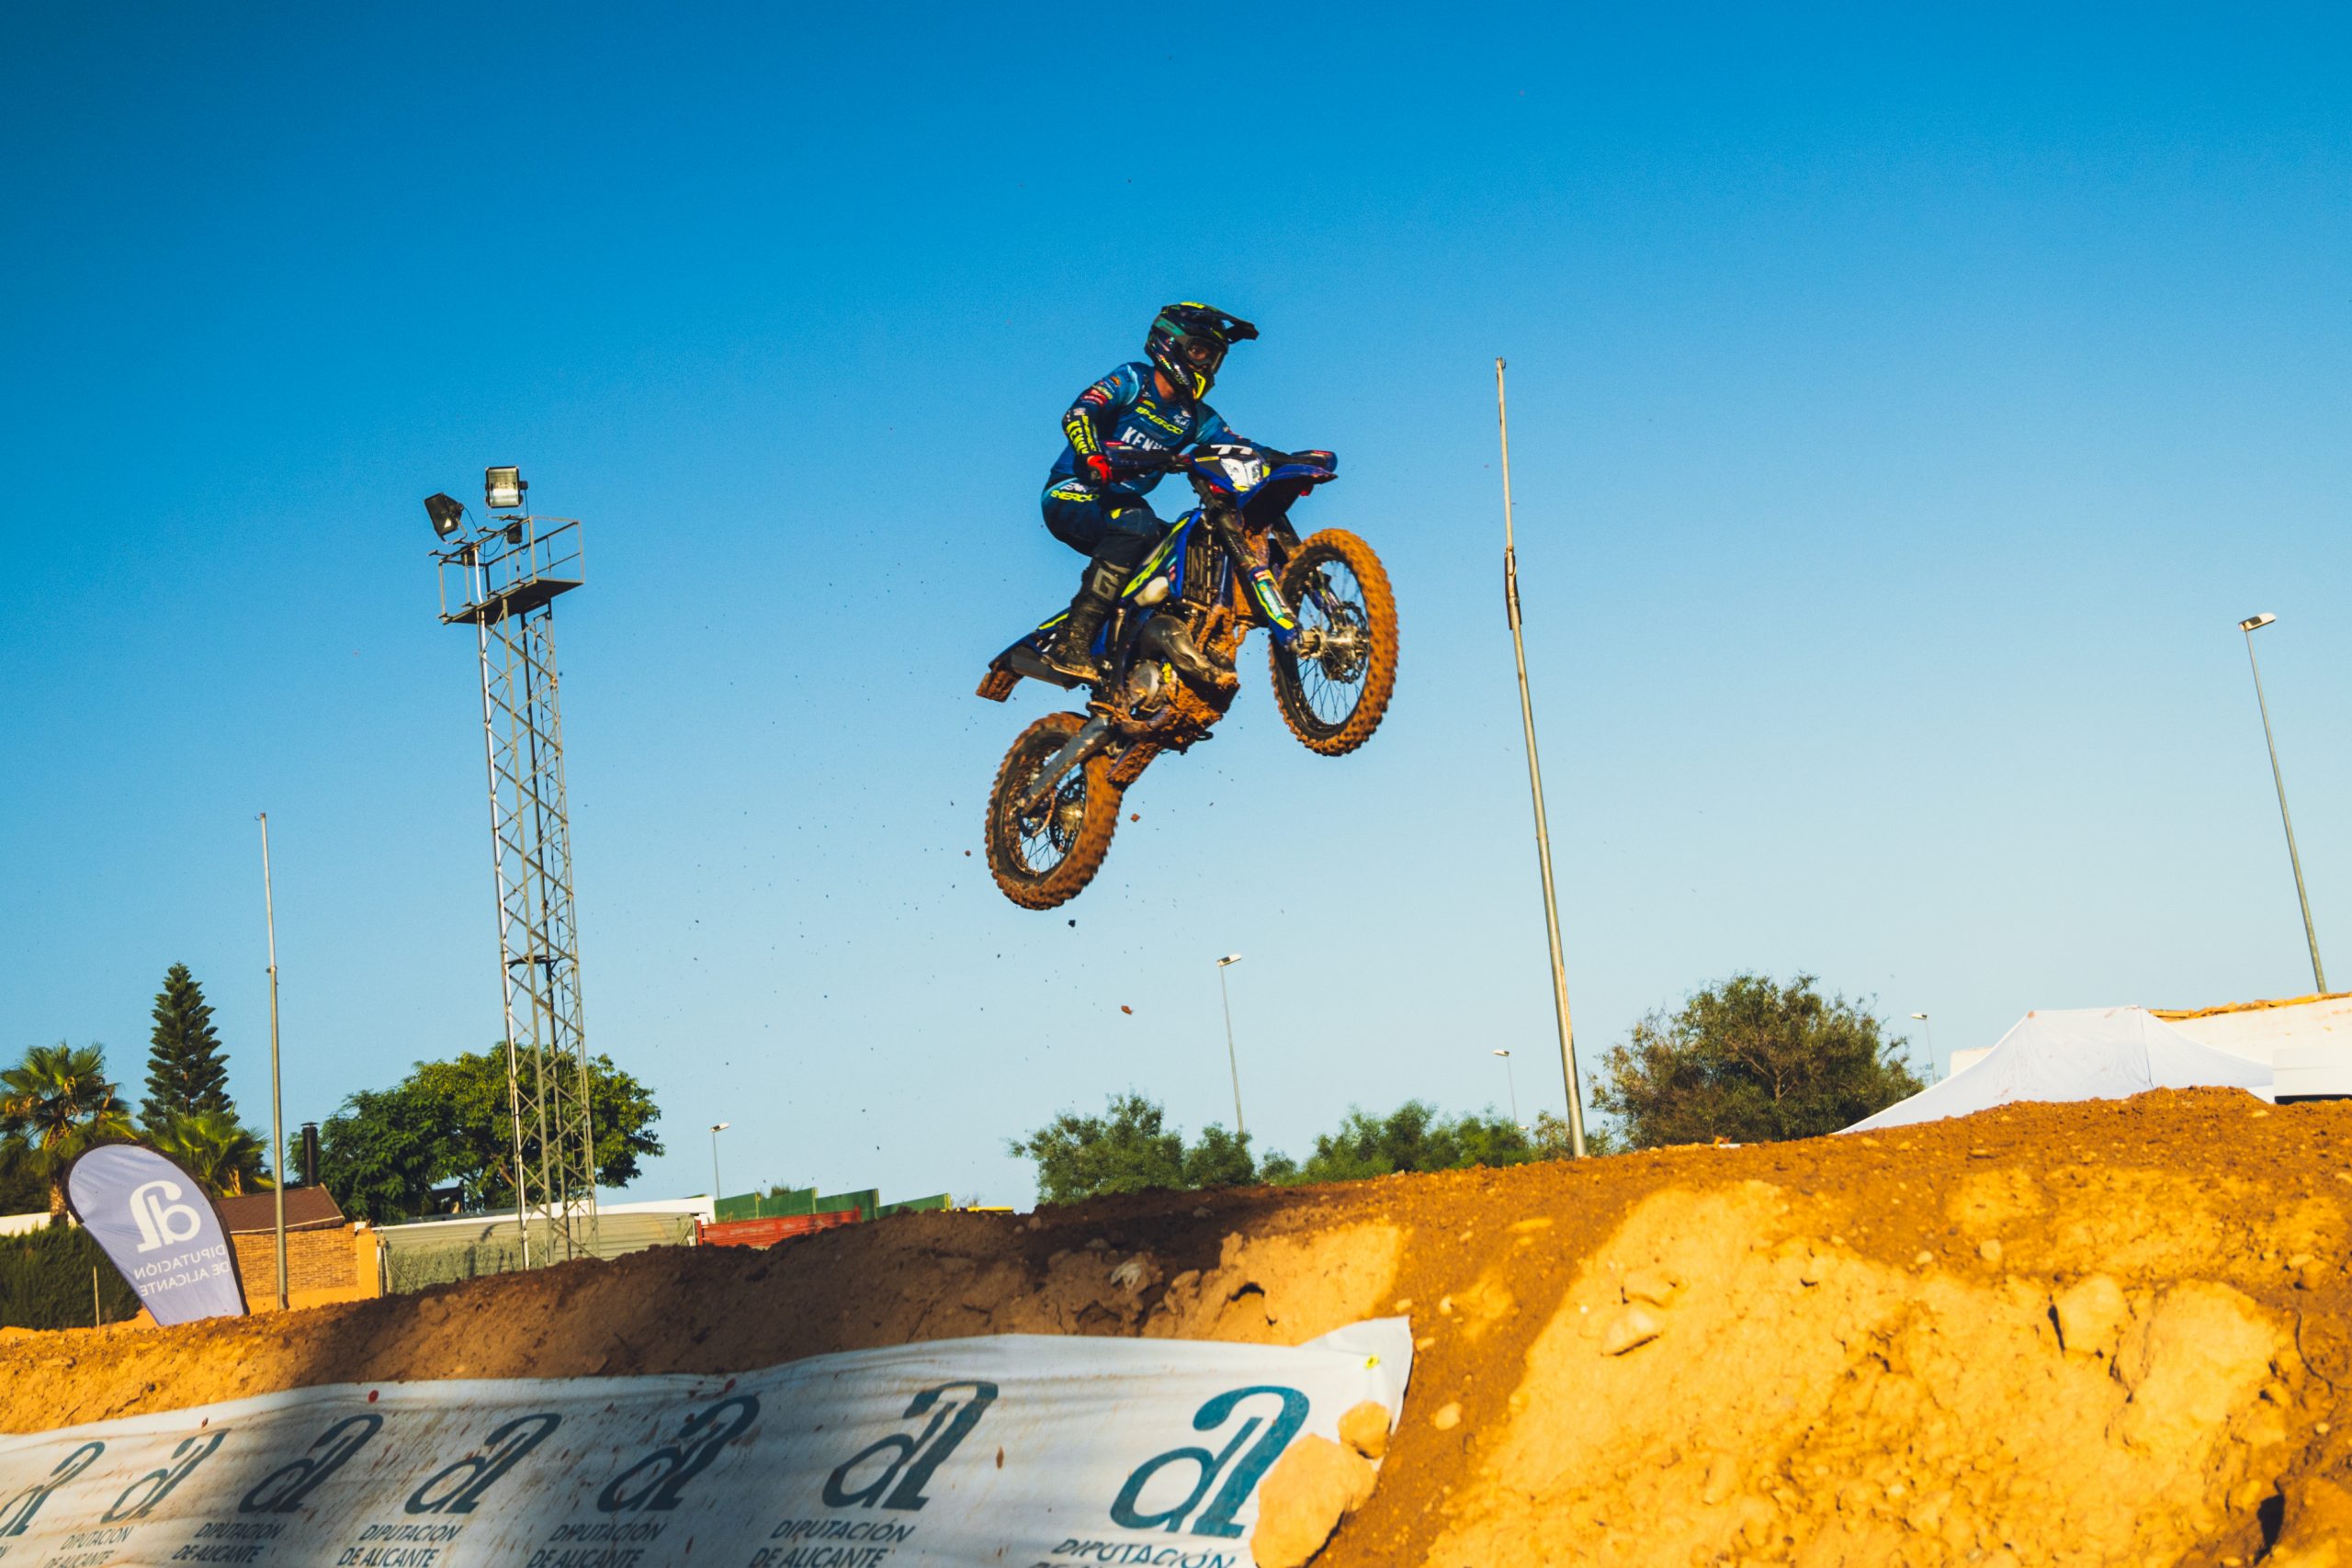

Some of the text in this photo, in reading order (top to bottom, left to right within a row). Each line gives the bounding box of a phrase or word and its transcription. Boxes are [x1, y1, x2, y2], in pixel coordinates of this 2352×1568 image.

[770, 1517, 916, 1543] DIPUTACIÓN
[171, 1544, 265, 1564] DE ALICANTE
[337, 1547, 441, 1568] DE ALICANTE
[550, 1549, 646, 1568] ALICANTE
[776, 1547, 889, 1568] ALICANTE
